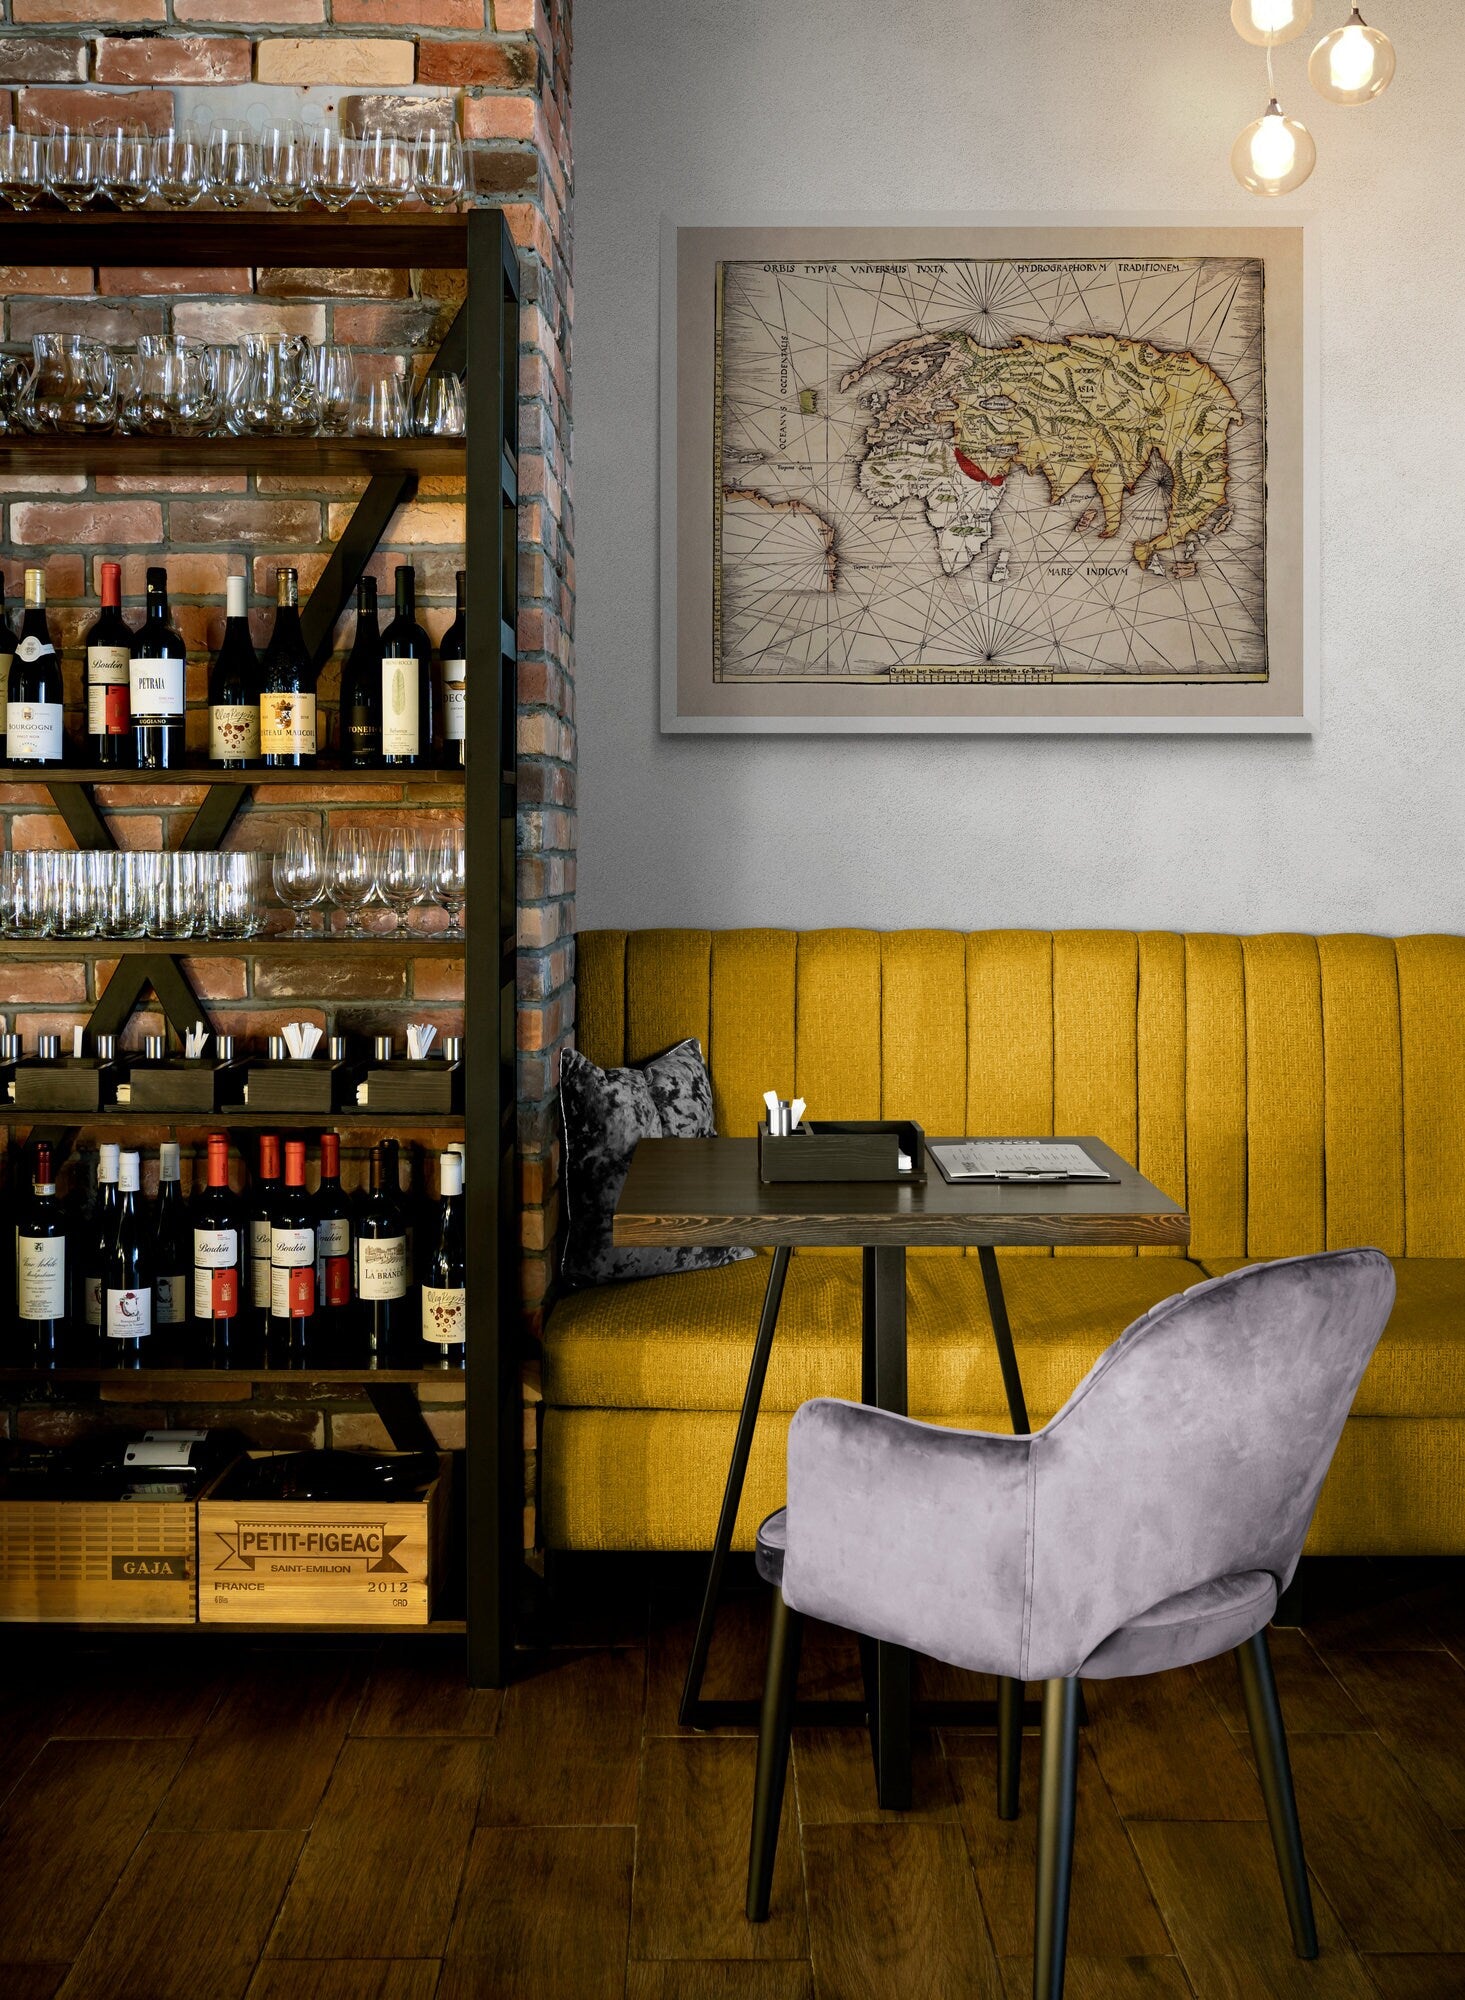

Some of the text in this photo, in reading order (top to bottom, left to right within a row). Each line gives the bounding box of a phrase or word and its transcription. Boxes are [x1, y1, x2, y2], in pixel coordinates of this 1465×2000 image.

[763, 264, 795, 273] ORBIS
[804, 265, 837, 273] TYPVS
[1118, 263, 1180, 272] TRADITIONEM
[780, 335, 789, 395] OCCIDENTALIS
[1077, 385, 1095, 393] ASIA
[1048, 567, 1129, 576] MARE INDICVM
[92, 659, 123, 669] Bordón
[138, 677, 165, 690] PETRAIA
[443, 693, 466, 703] DEC
[8, 723, 53, 731] BOURGOGNE
[286, 729, 315, 737] MAUCOIL
[199, 1242, 229, 1253] Bordón
[276, 1242, 306, 1252] Bordón
[364, 1268, 376, 1280] LA
[243, 1531, 380, 1553] PETIT-FIGEAC
[123, 1561, 174, 1575] GAJA
[270, 1564, 351, 1574] SAINT-EMILION
[214, 1581, 408, 1593] FRANCE 2012
[392, 1599, 408, 1607] CRD
